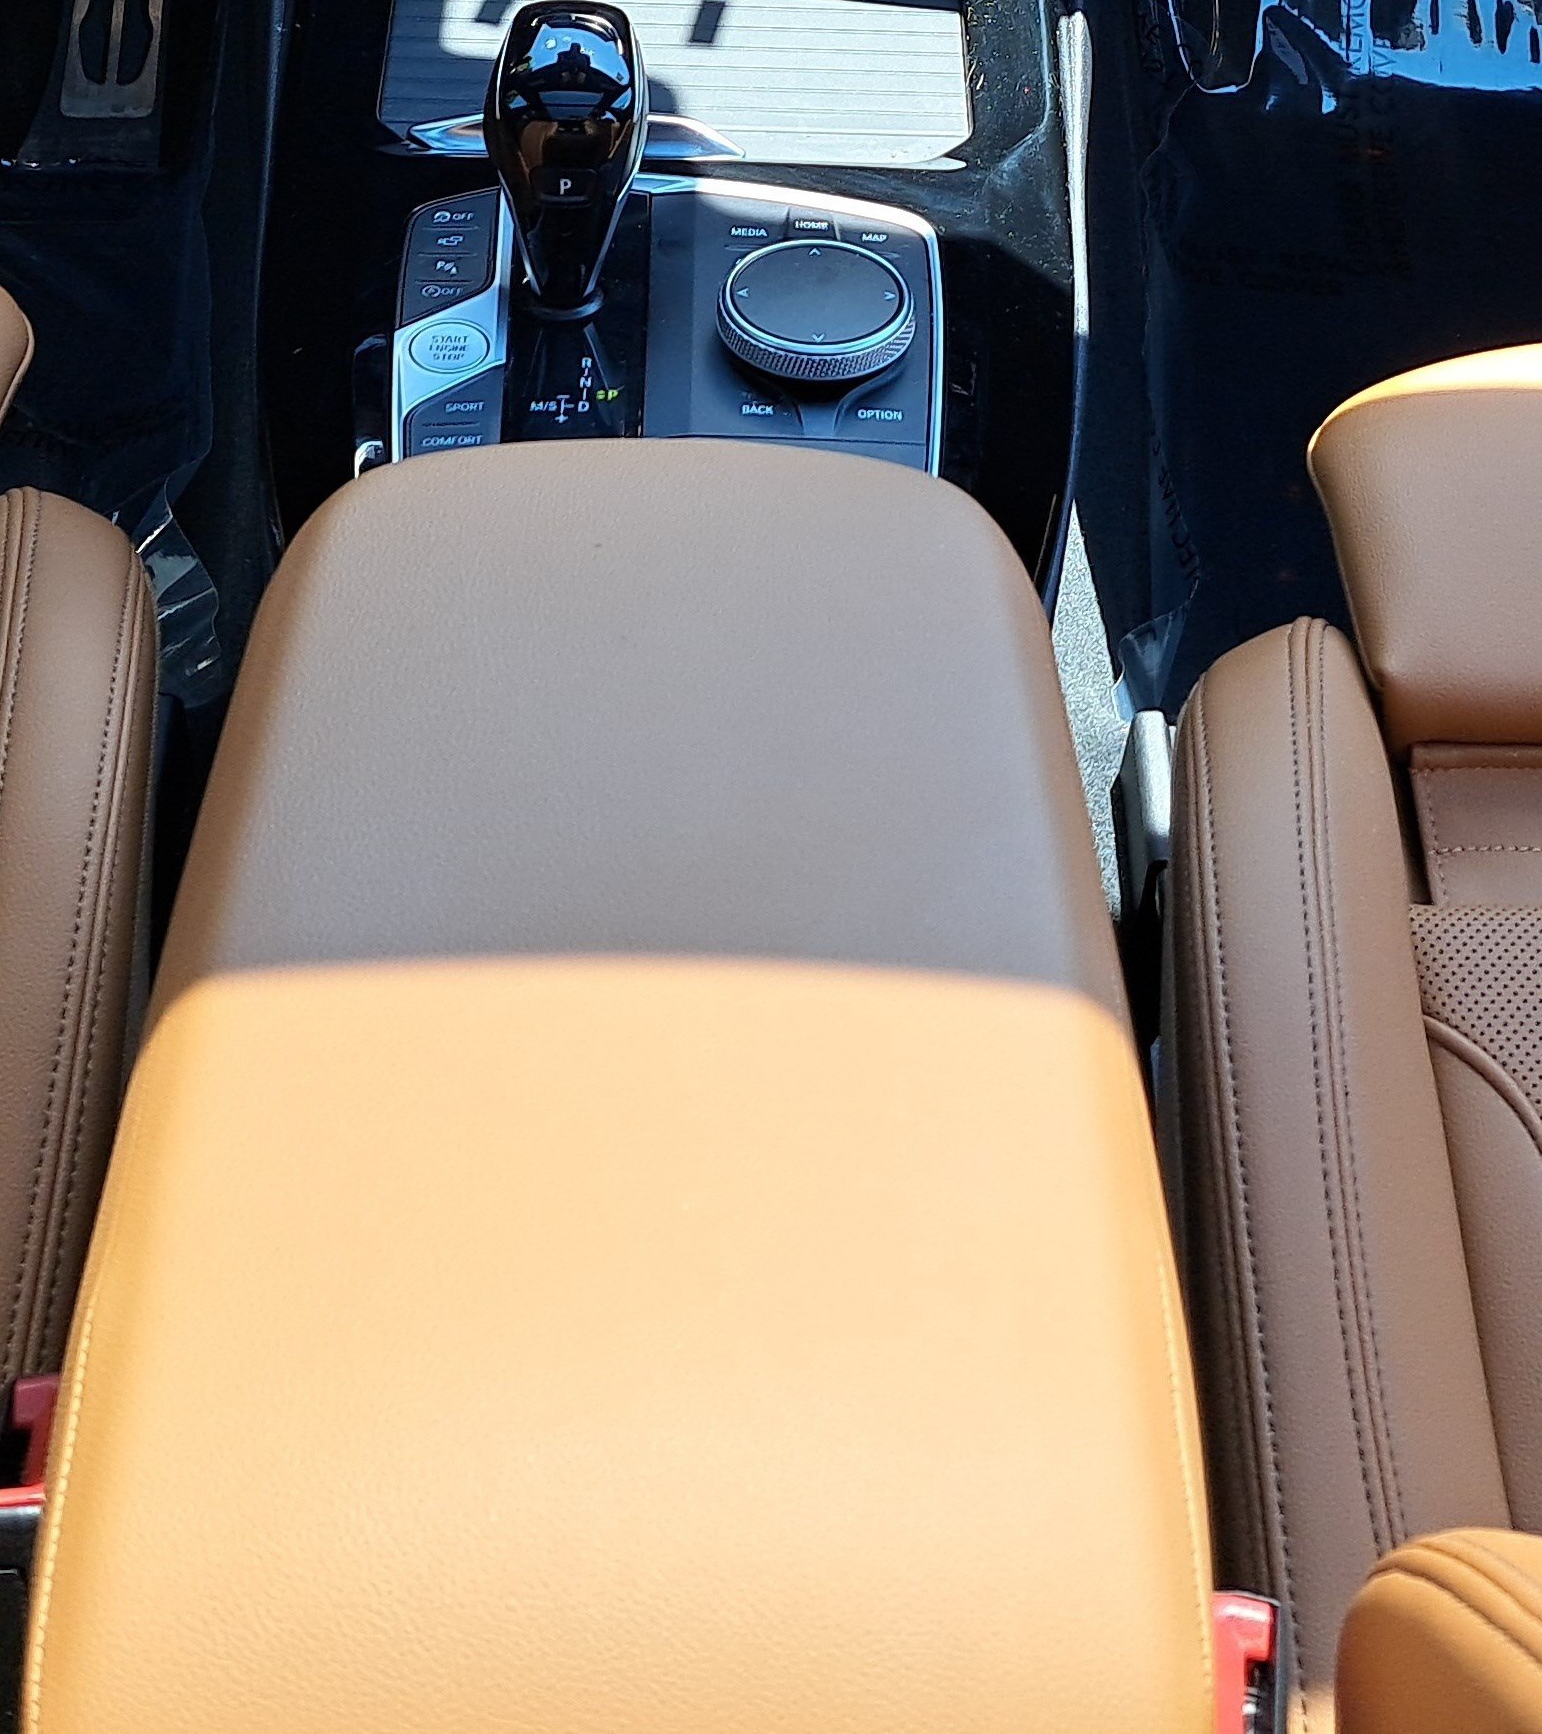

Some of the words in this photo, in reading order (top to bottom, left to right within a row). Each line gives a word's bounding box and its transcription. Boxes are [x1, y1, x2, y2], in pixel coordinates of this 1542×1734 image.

[560, 179, 571, 195] P
[452, 212, 474, 221] OFF
[731, 226, 768, 237] MEDIA
[861, 232, 887, 242] MAP
[445, 400, 485, 413] SPORT
[530, 400, 558, 412] M/S
[741, 403, 774, 415] BACK
[857, 408, 903, 421] OPTION
[422, 434, 484, 447] COMFORT
